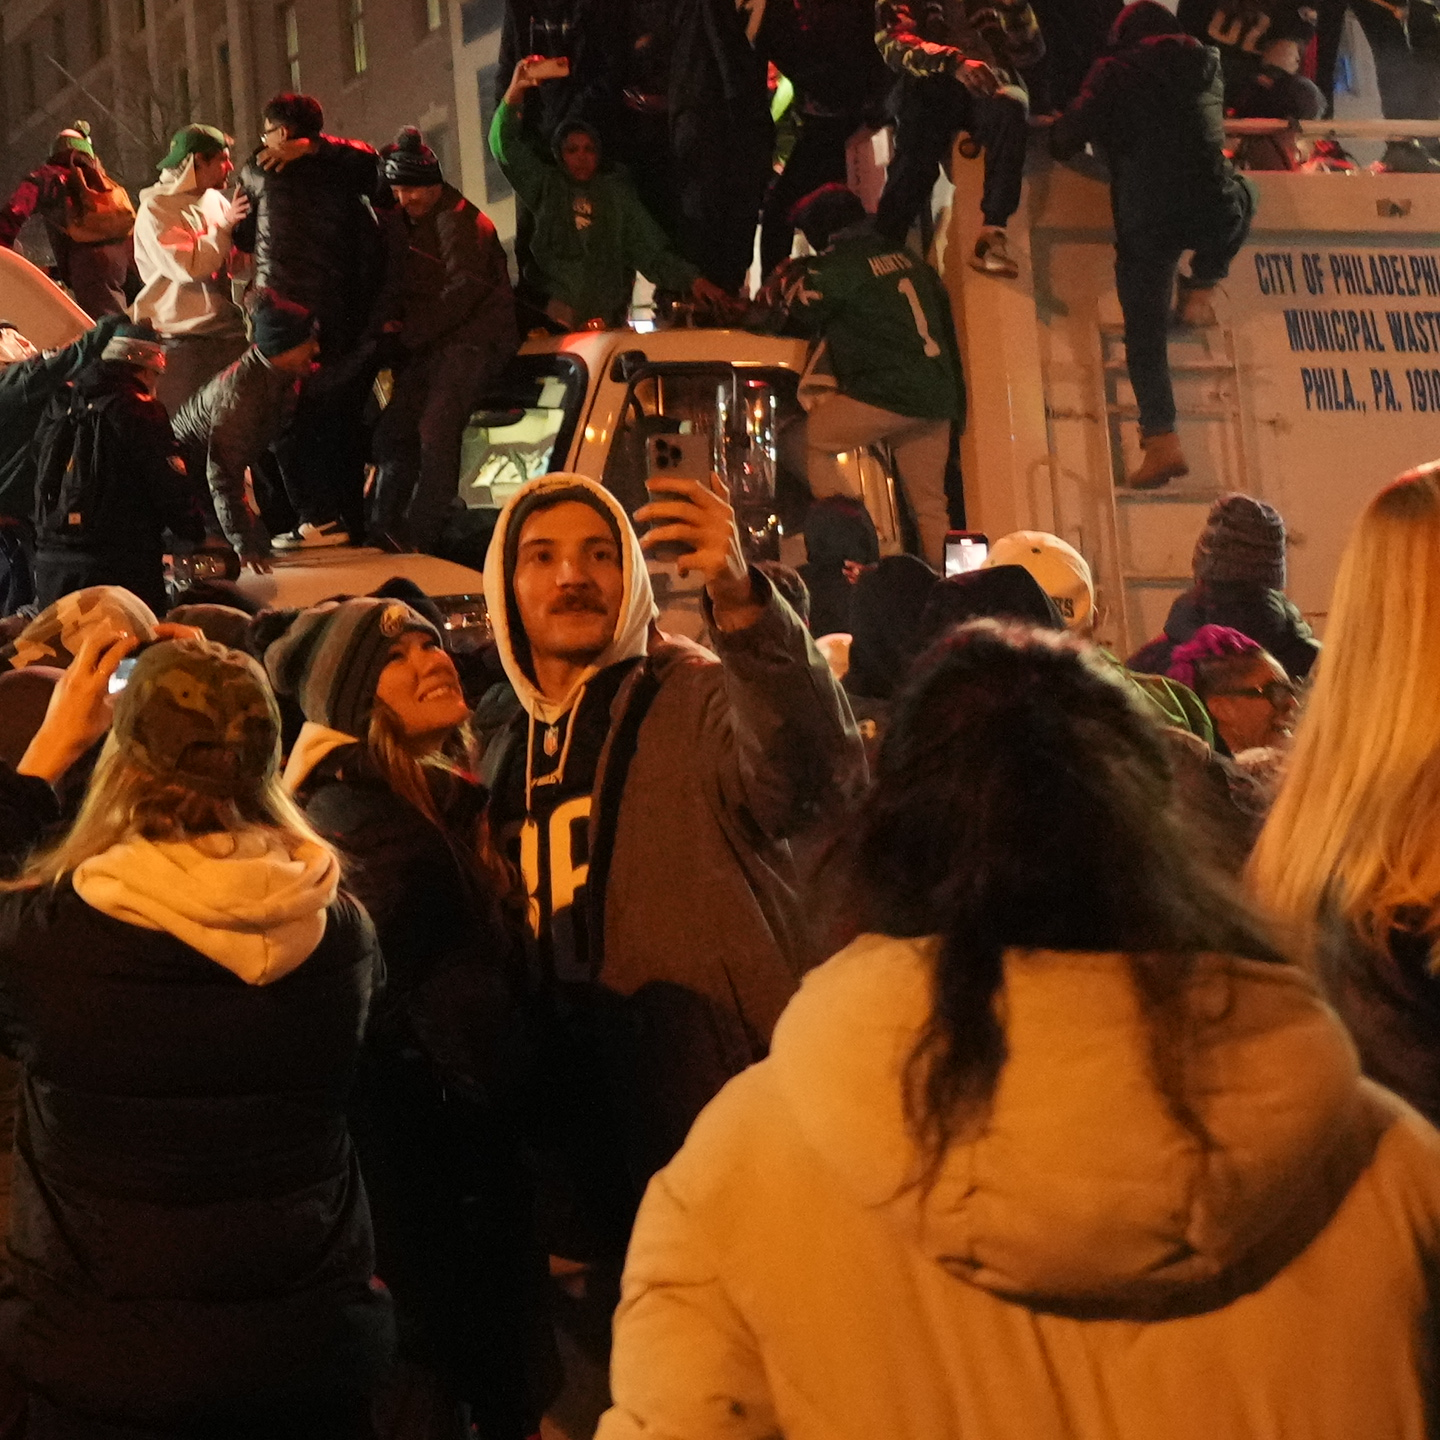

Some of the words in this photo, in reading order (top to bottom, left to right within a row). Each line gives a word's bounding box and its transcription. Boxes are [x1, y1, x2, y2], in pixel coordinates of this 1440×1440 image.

[1254, 252, 1297, 296] CITY
[1301, 252, 1325, 296] OF
[1328, 252, 1440, 297] PHILADELPHI
[898, 278, 941, 357] 1
[1283, 310, 1386, 353] MUNICIPAL
[1370, 367, 1402, 413] PA.
[1406, 368, 1440, 413] 1910
